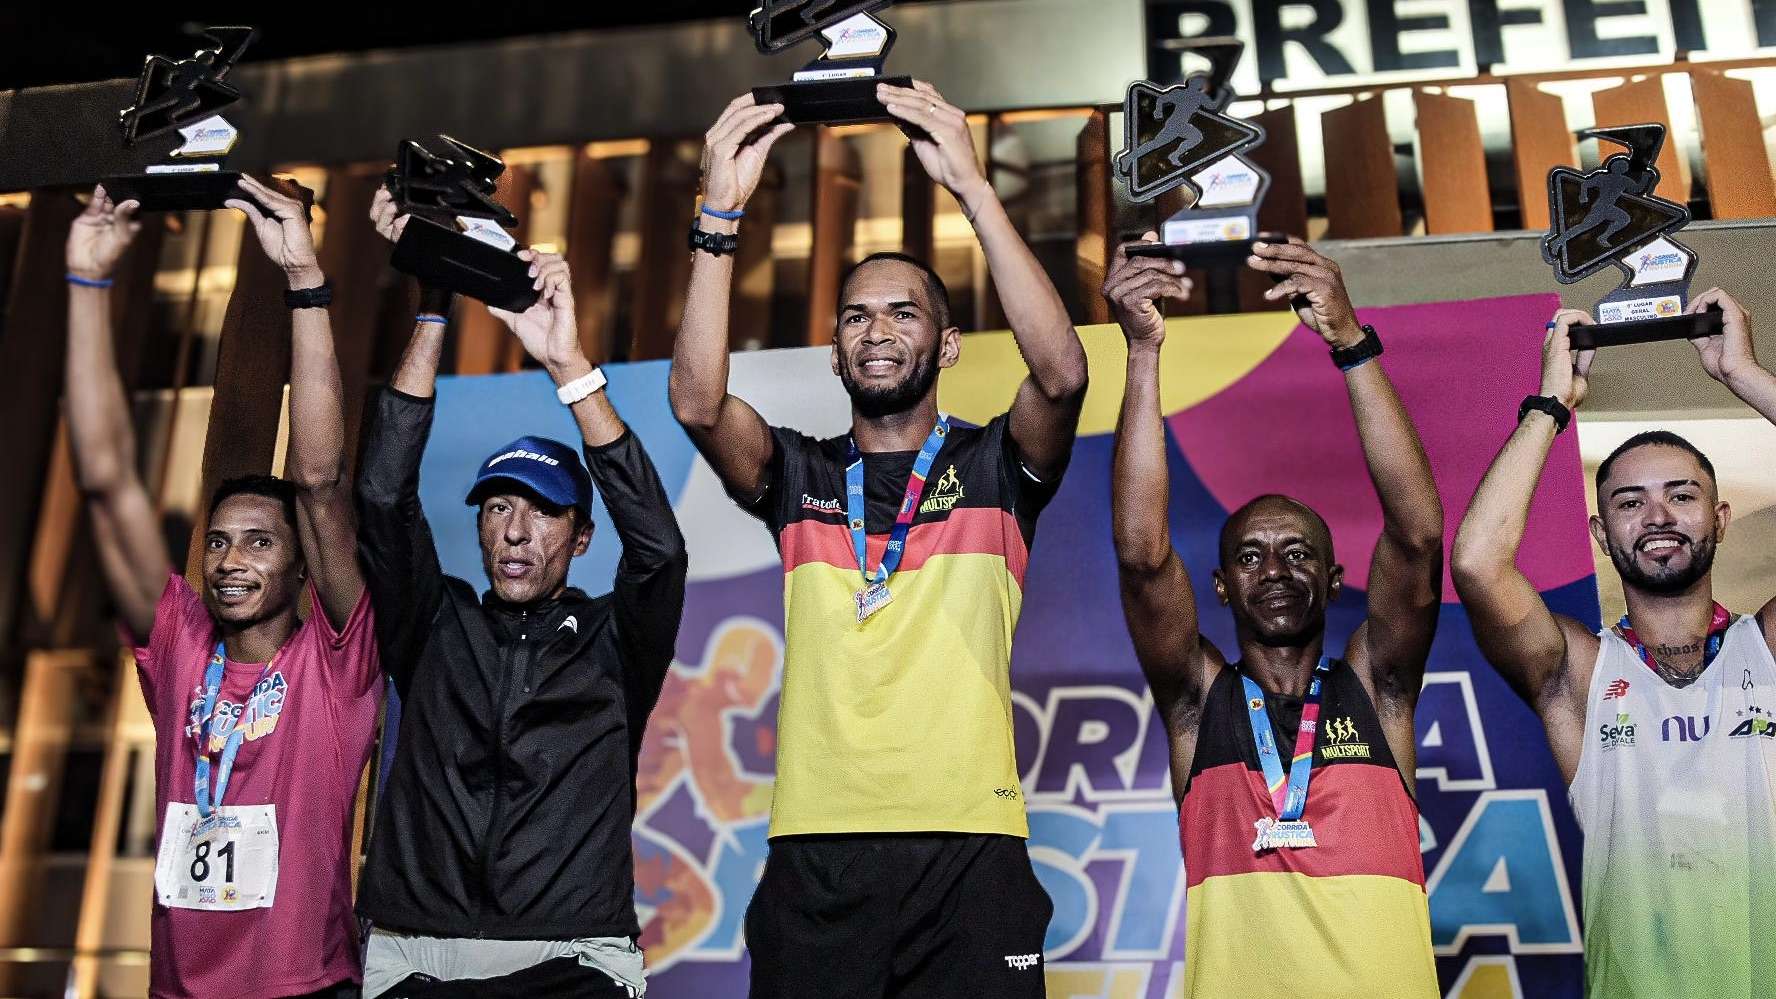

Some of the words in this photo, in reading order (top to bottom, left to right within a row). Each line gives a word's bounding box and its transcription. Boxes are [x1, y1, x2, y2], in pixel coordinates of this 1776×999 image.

[1147, 0, 1776, 84] PREFEI
[1321, 744, 1370, 758] MULTSPORT
[190, 841, 235, 883] 81
